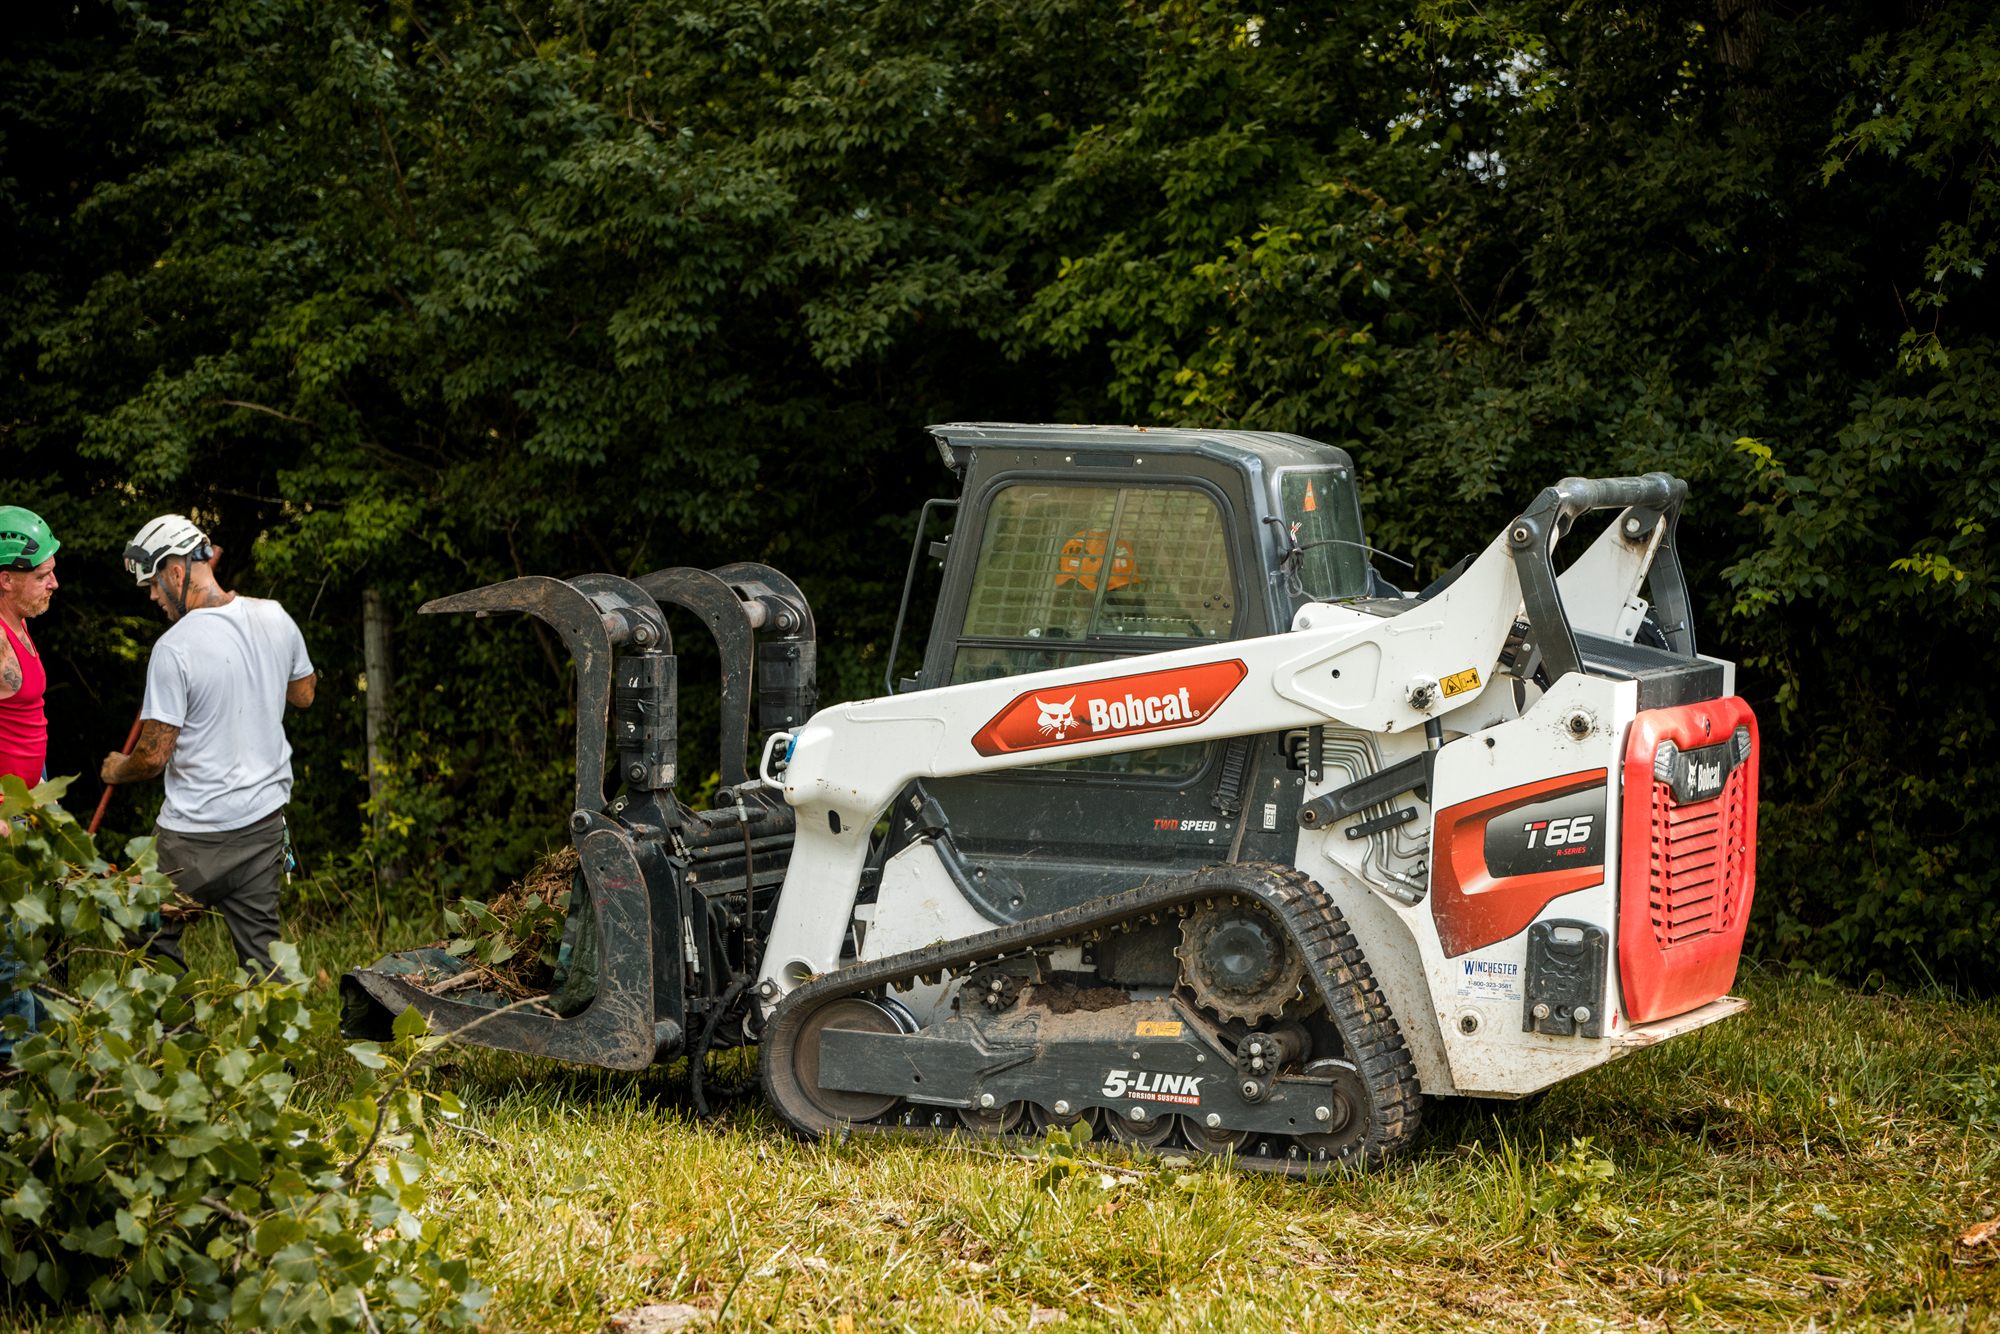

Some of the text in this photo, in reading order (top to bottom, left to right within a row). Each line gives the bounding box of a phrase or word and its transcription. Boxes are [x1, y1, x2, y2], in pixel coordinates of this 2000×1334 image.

[1088, 687, 1193, 732] Bobcat
[1153, 819, 1217, 831] TWO SPEED
[1524, 815, 1594, 849] T66
[1556, 846, 1586, 856] R-SERIES
[1102, 1069, 1204, 1098] 5-LINK
[1128, 1091, 1198, 1105] TORSION SUSPENSION
